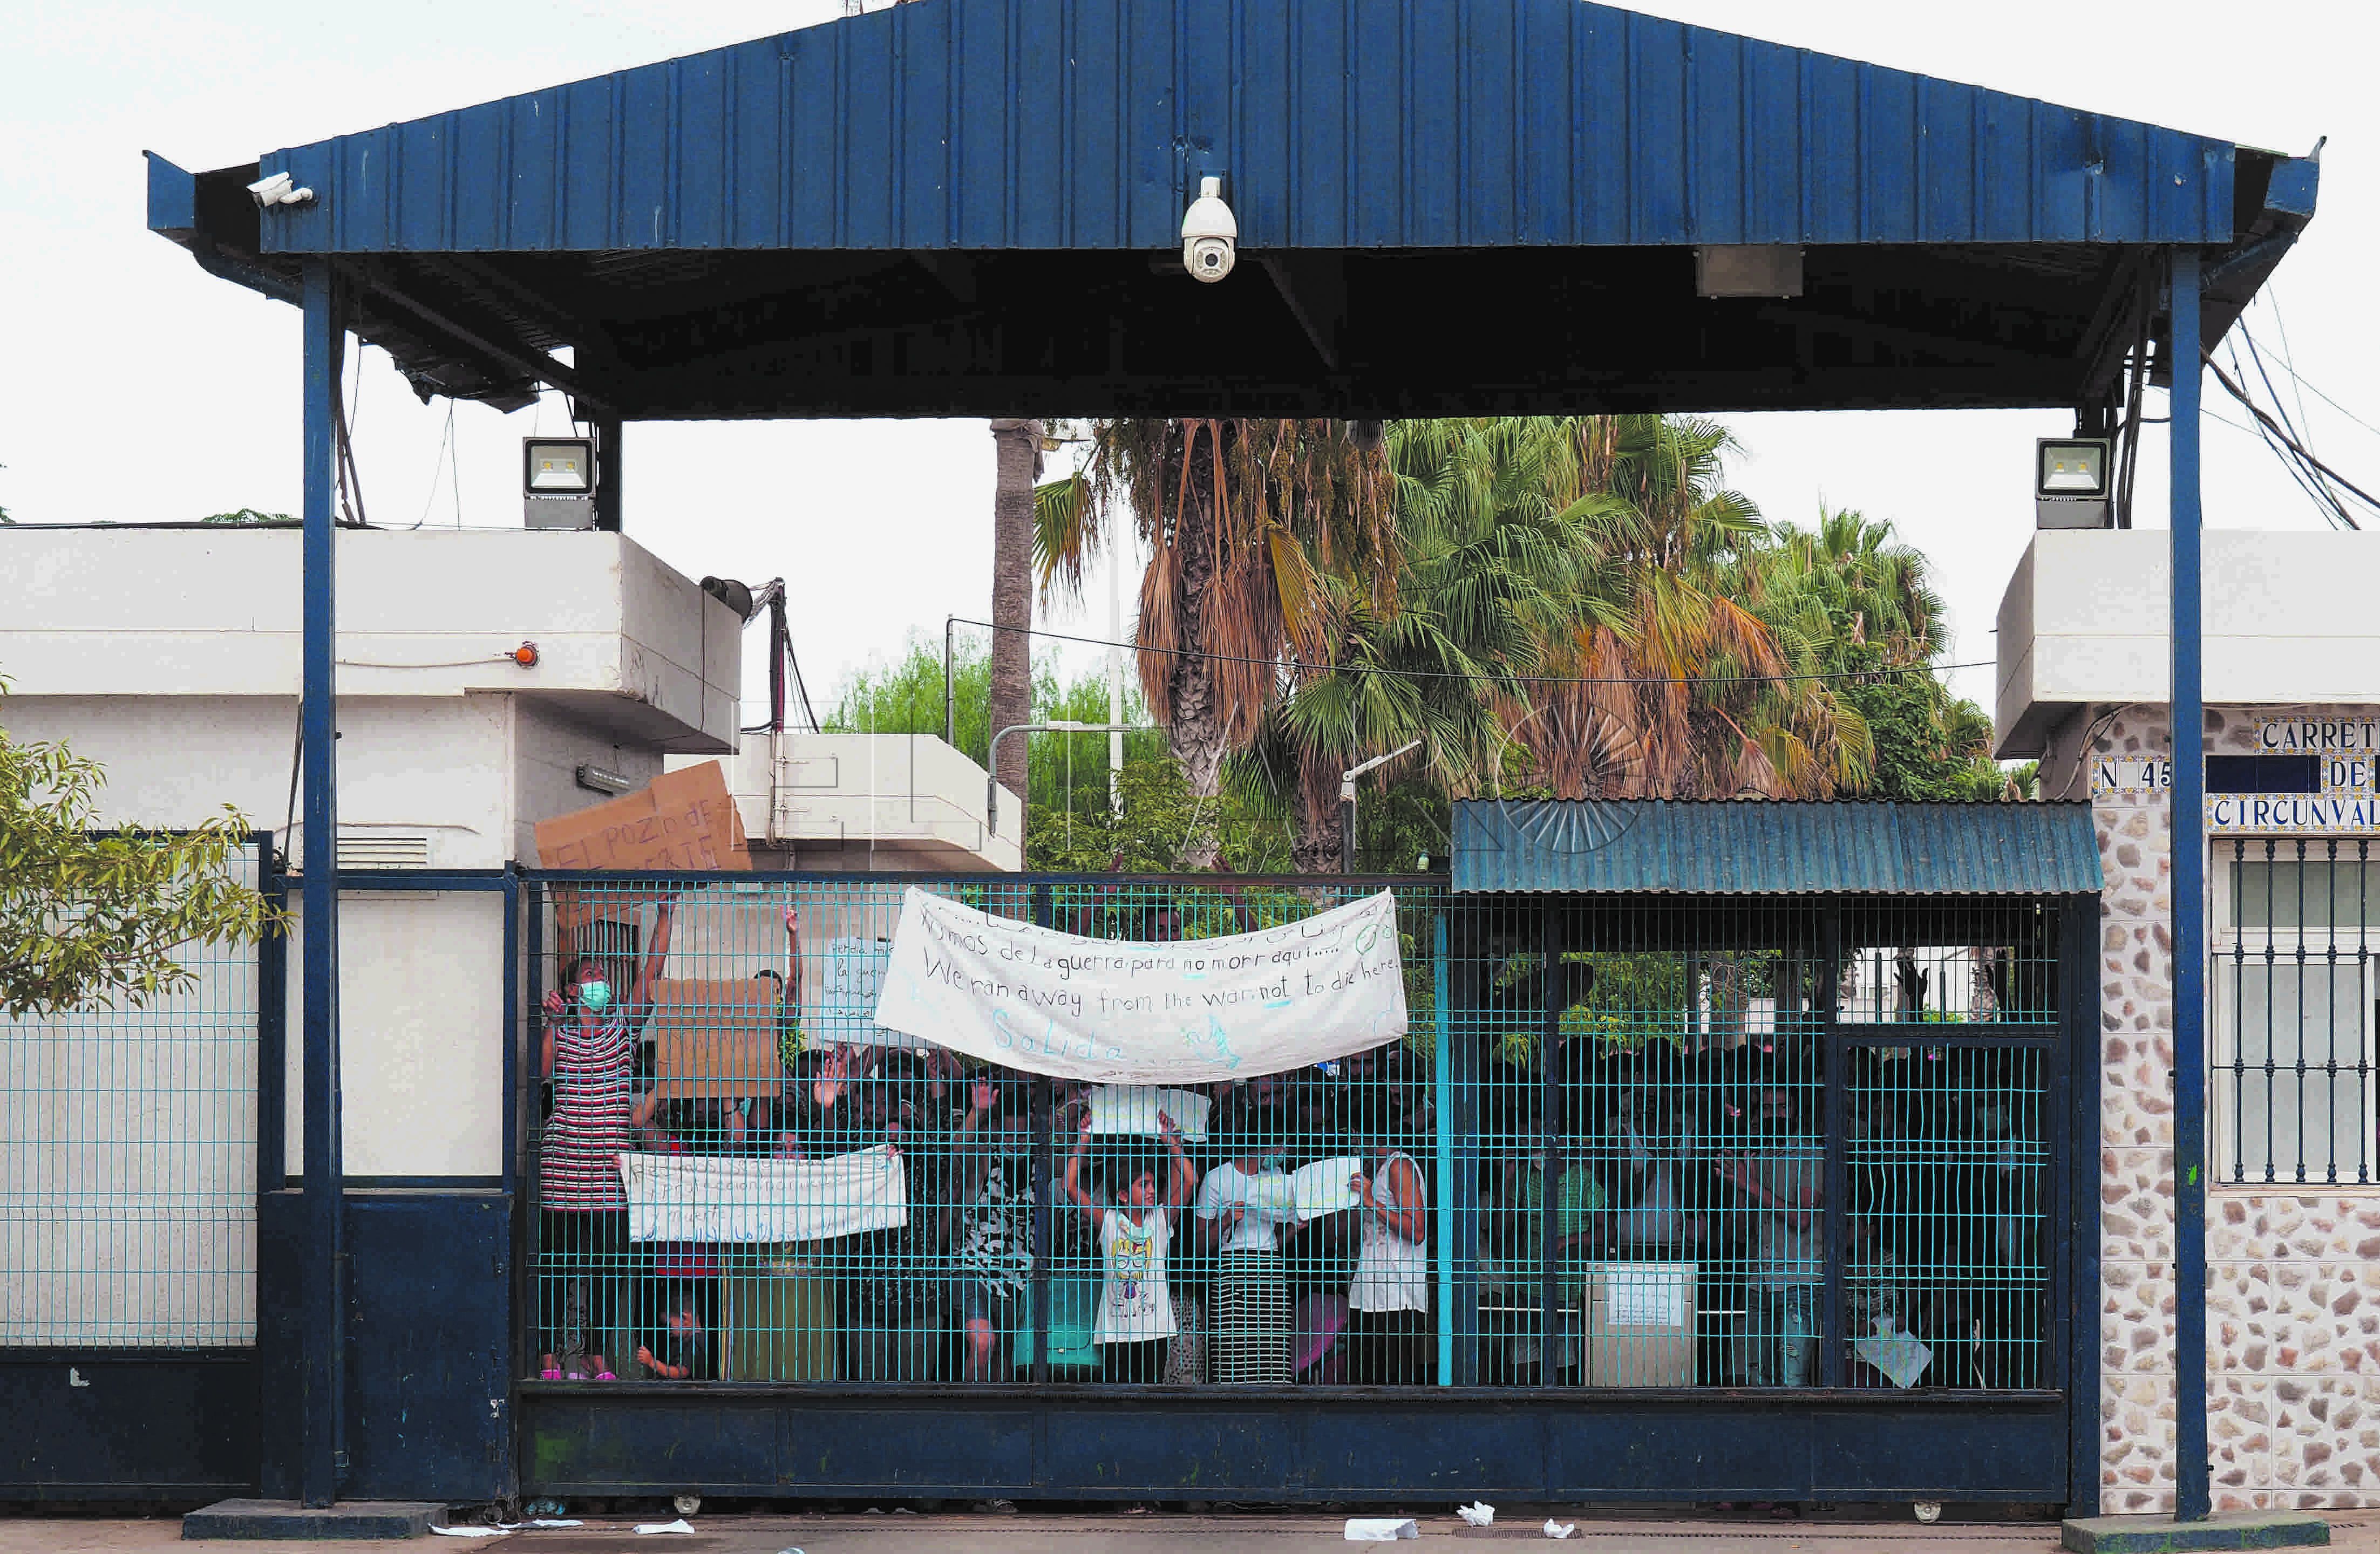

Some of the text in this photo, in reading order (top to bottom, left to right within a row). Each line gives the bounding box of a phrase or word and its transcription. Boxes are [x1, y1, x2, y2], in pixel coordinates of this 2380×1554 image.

[2263, 723, 2375, 748] CARRET
[2331, 761, 2367, 787] DE
[2215, 800, 2380, 826] CIRCUNVAL
[924, 945, 964, 990] We
[971, 977, 1010, 998] ran
[1097, 989, 1152, 1014] from
[1260, 974, 1291, 999] not
